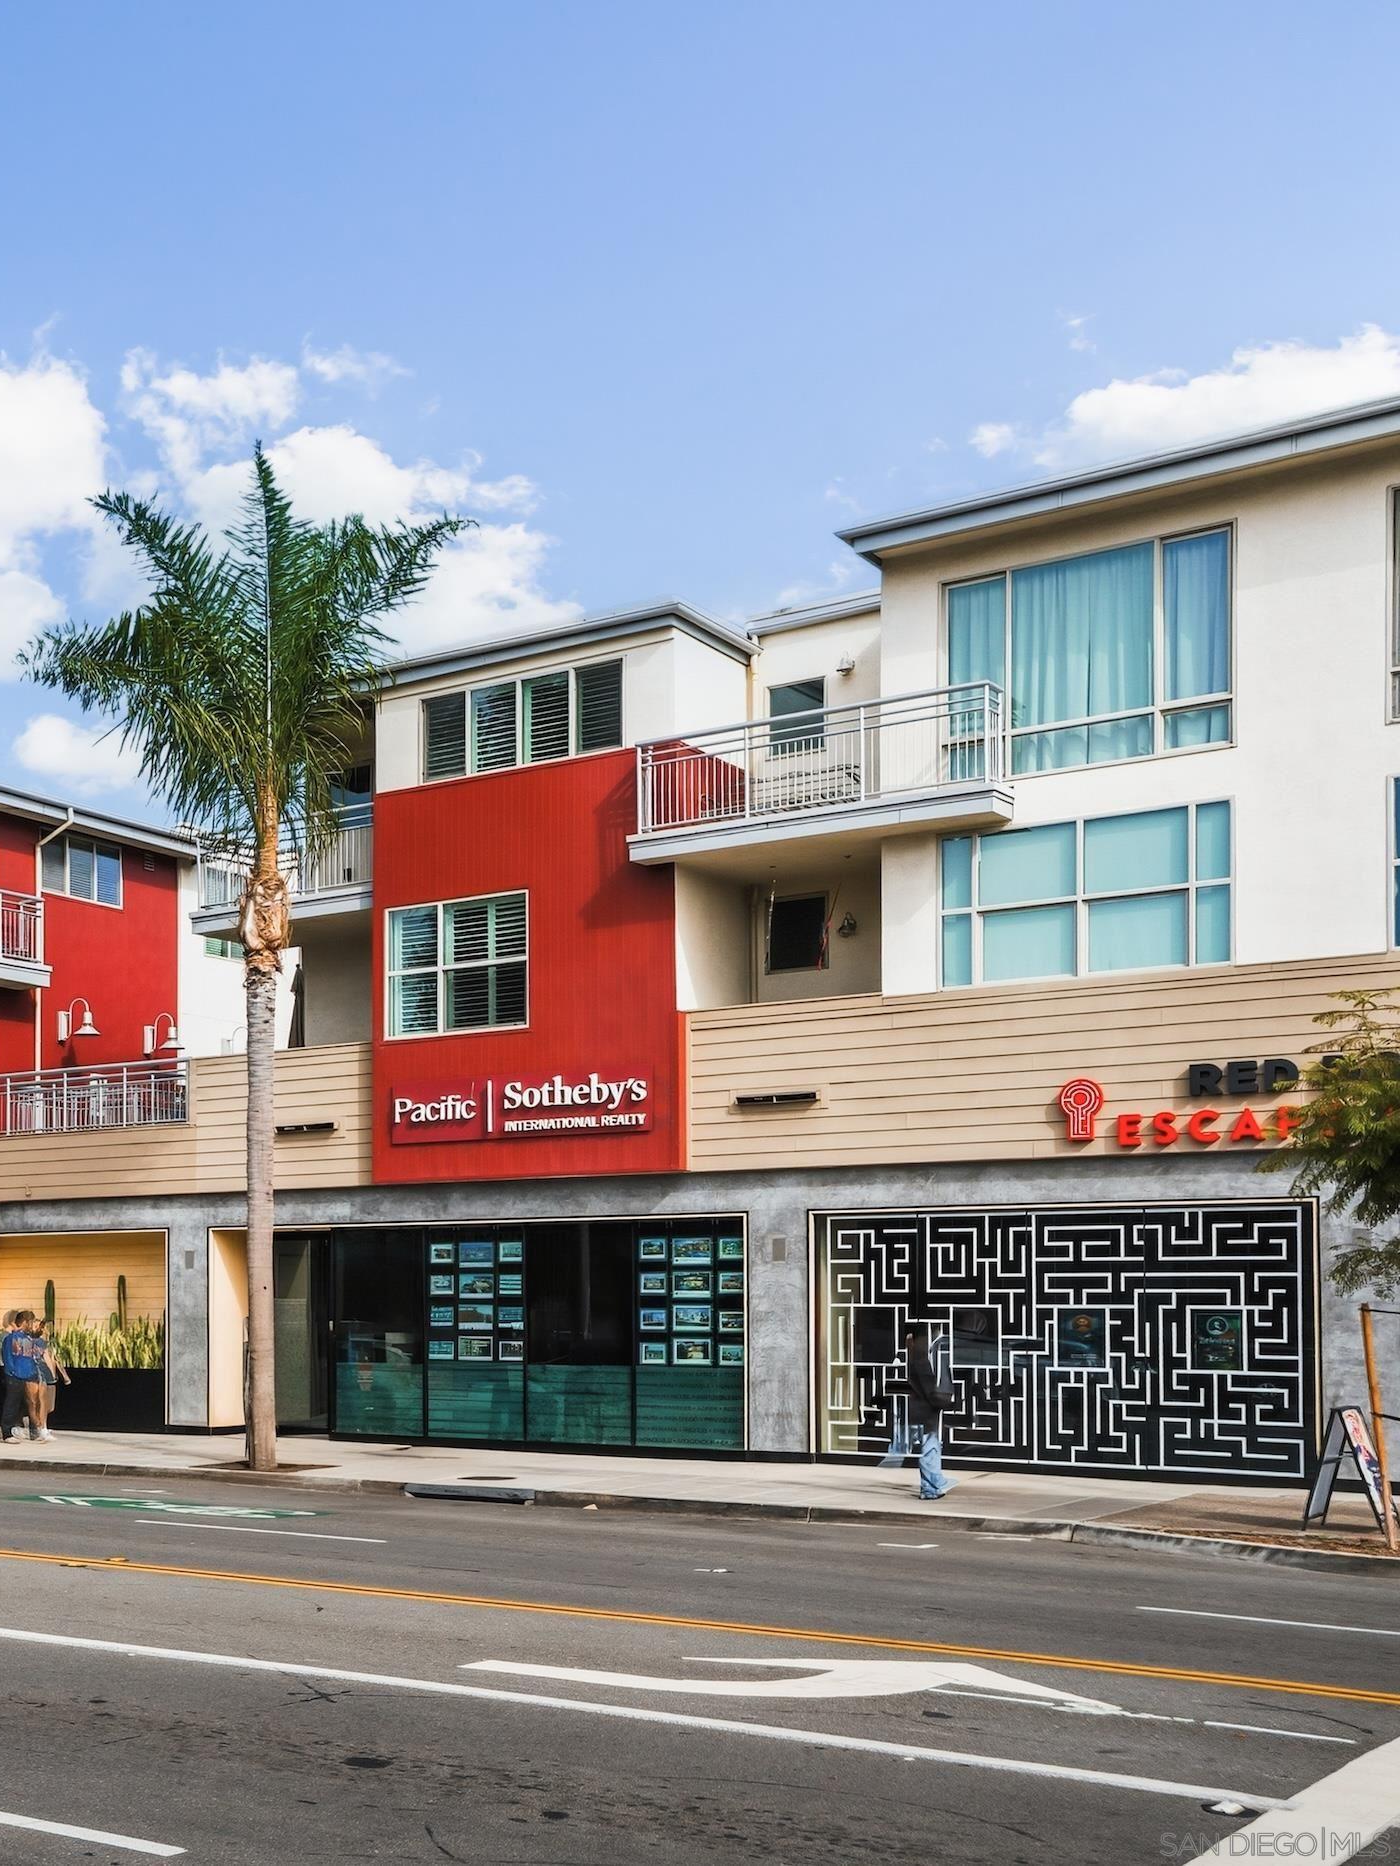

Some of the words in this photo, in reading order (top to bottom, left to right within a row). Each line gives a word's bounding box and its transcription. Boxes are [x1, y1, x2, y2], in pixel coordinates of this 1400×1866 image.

[1188, 1058, 1300, 1097] RED
[393, 1094, 477, 1123] Pacific
[503, 1073, 648, 1110] Sotheby's
[504, 1115, 600, 1132] INTERNATIONAL
[601, 1113, 647, 1127] REALTY
[1117, 1106, 1340, 1147] ESCAP
